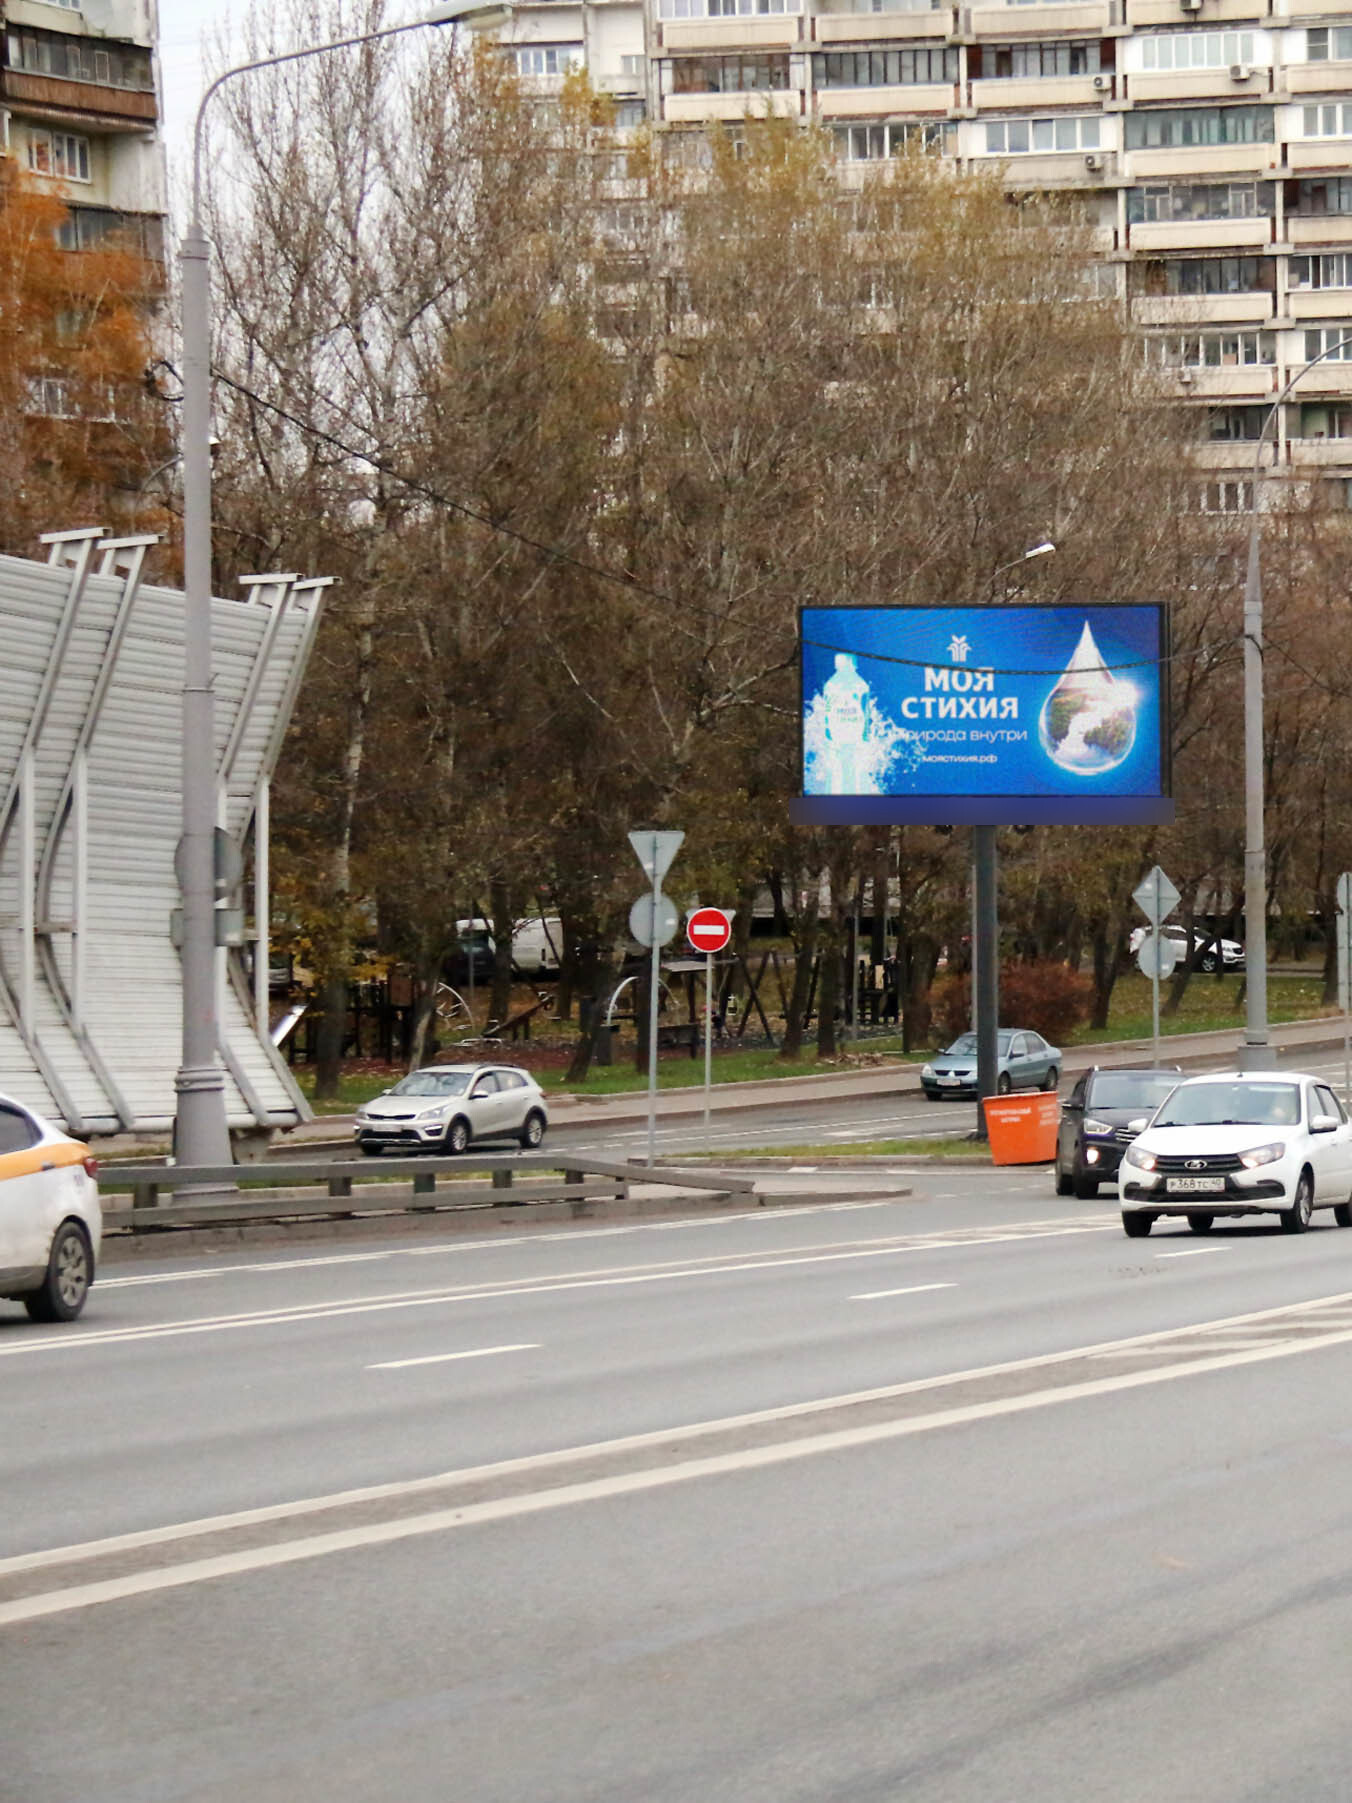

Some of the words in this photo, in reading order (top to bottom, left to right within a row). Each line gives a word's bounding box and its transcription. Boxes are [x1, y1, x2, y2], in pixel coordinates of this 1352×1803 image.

[924, 667, 995, 692] МОЯ
[900, 697, 1018, 719] СТИХИЯ
[970, 729, 1028, 744] внутри
